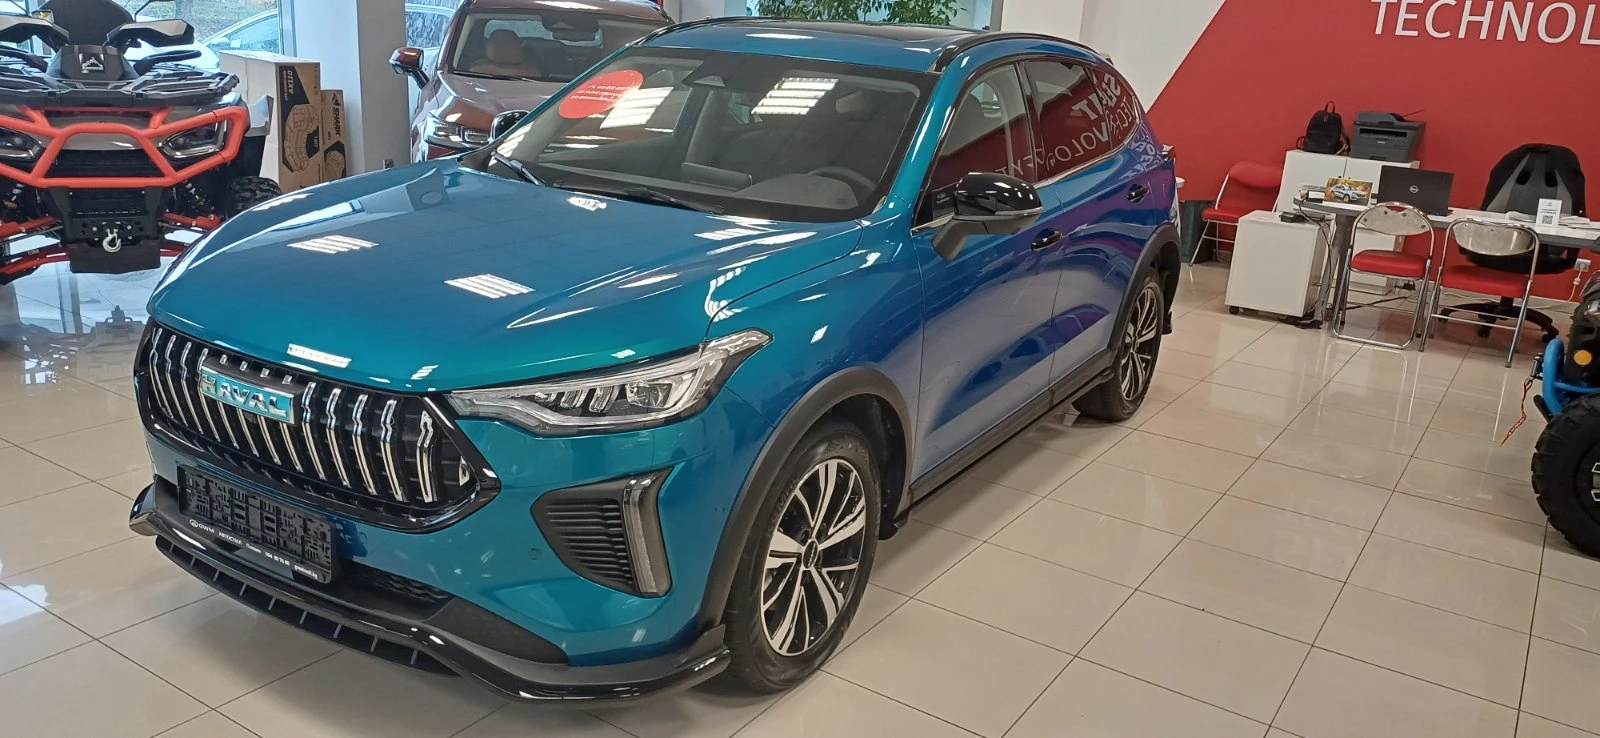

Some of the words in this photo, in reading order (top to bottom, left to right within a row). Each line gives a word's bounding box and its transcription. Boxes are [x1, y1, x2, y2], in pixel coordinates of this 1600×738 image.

[1371, 0, 1600, 45] TECHNOL
[333, 108, 342, 136] SHARK
[202, 374, 287, 417] HAVAL
